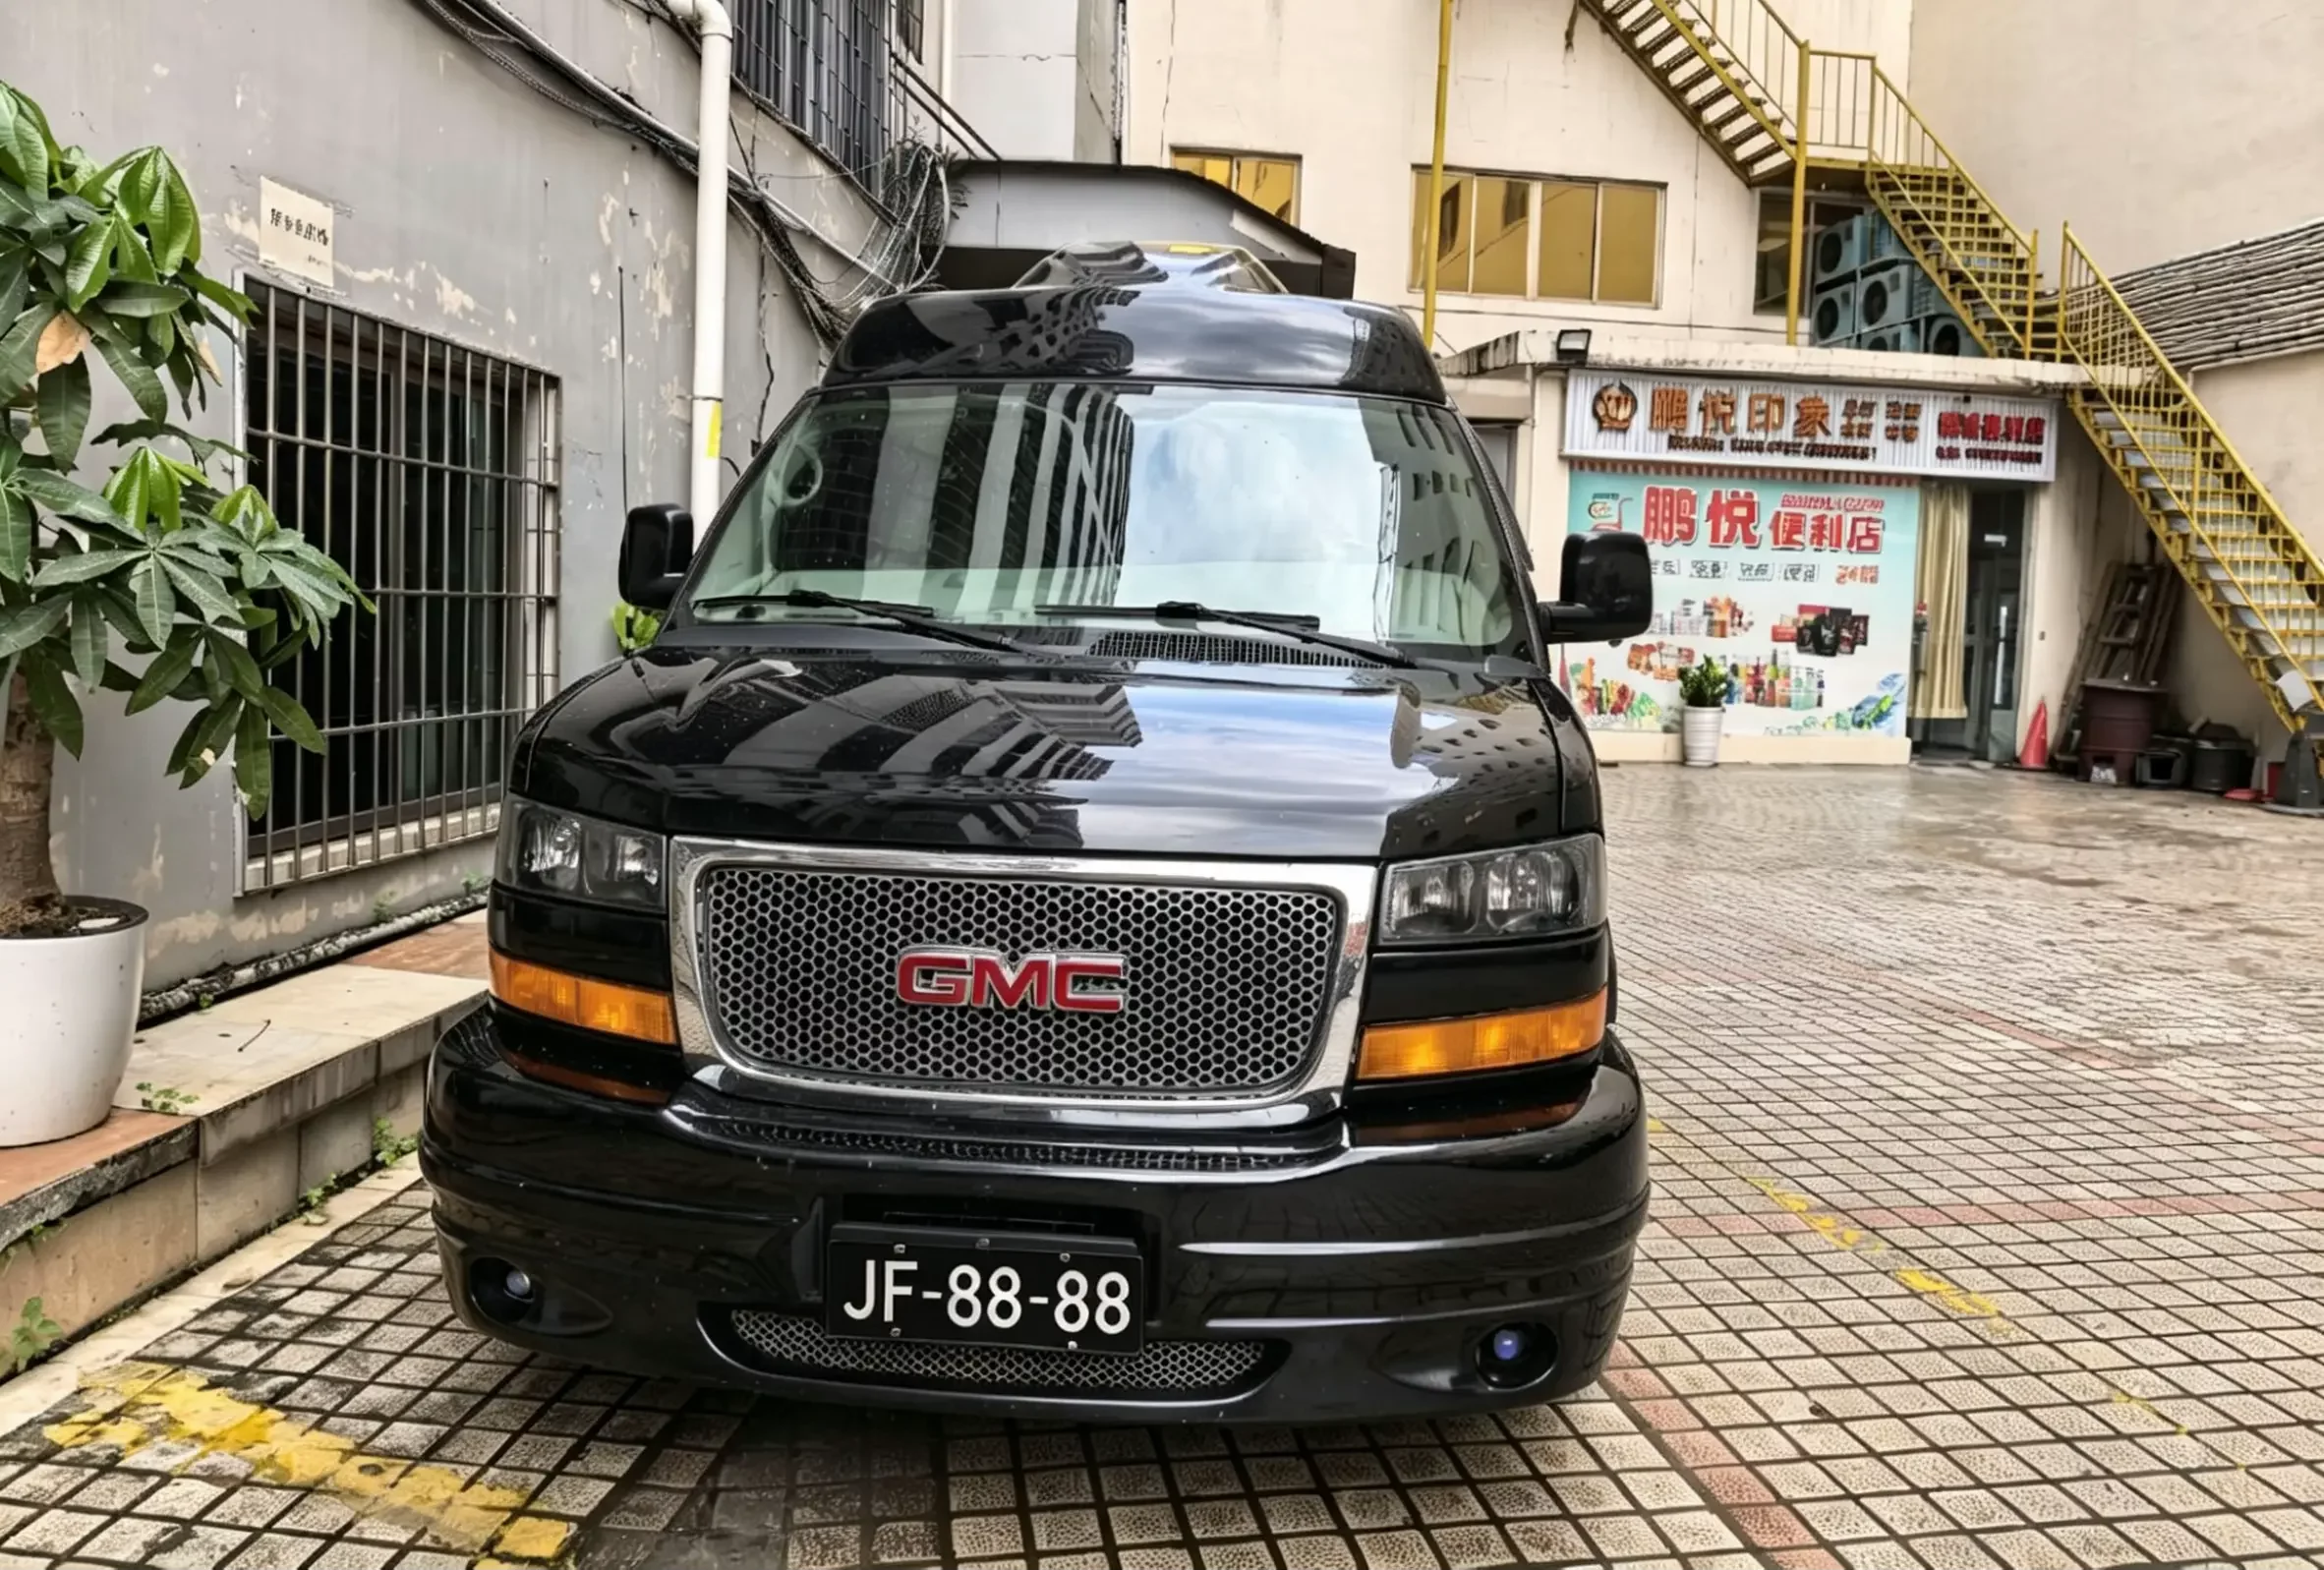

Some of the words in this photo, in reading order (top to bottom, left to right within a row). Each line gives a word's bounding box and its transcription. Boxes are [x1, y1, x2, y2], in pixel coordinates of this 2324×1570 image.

[1643, 485, 1761, 548] 鹏悦
[1770, 510, 1885, 553] 便利店
[896, 946, 1125, 1014] GMC
[843, 1259, 1131, 1335] JF-88-88
